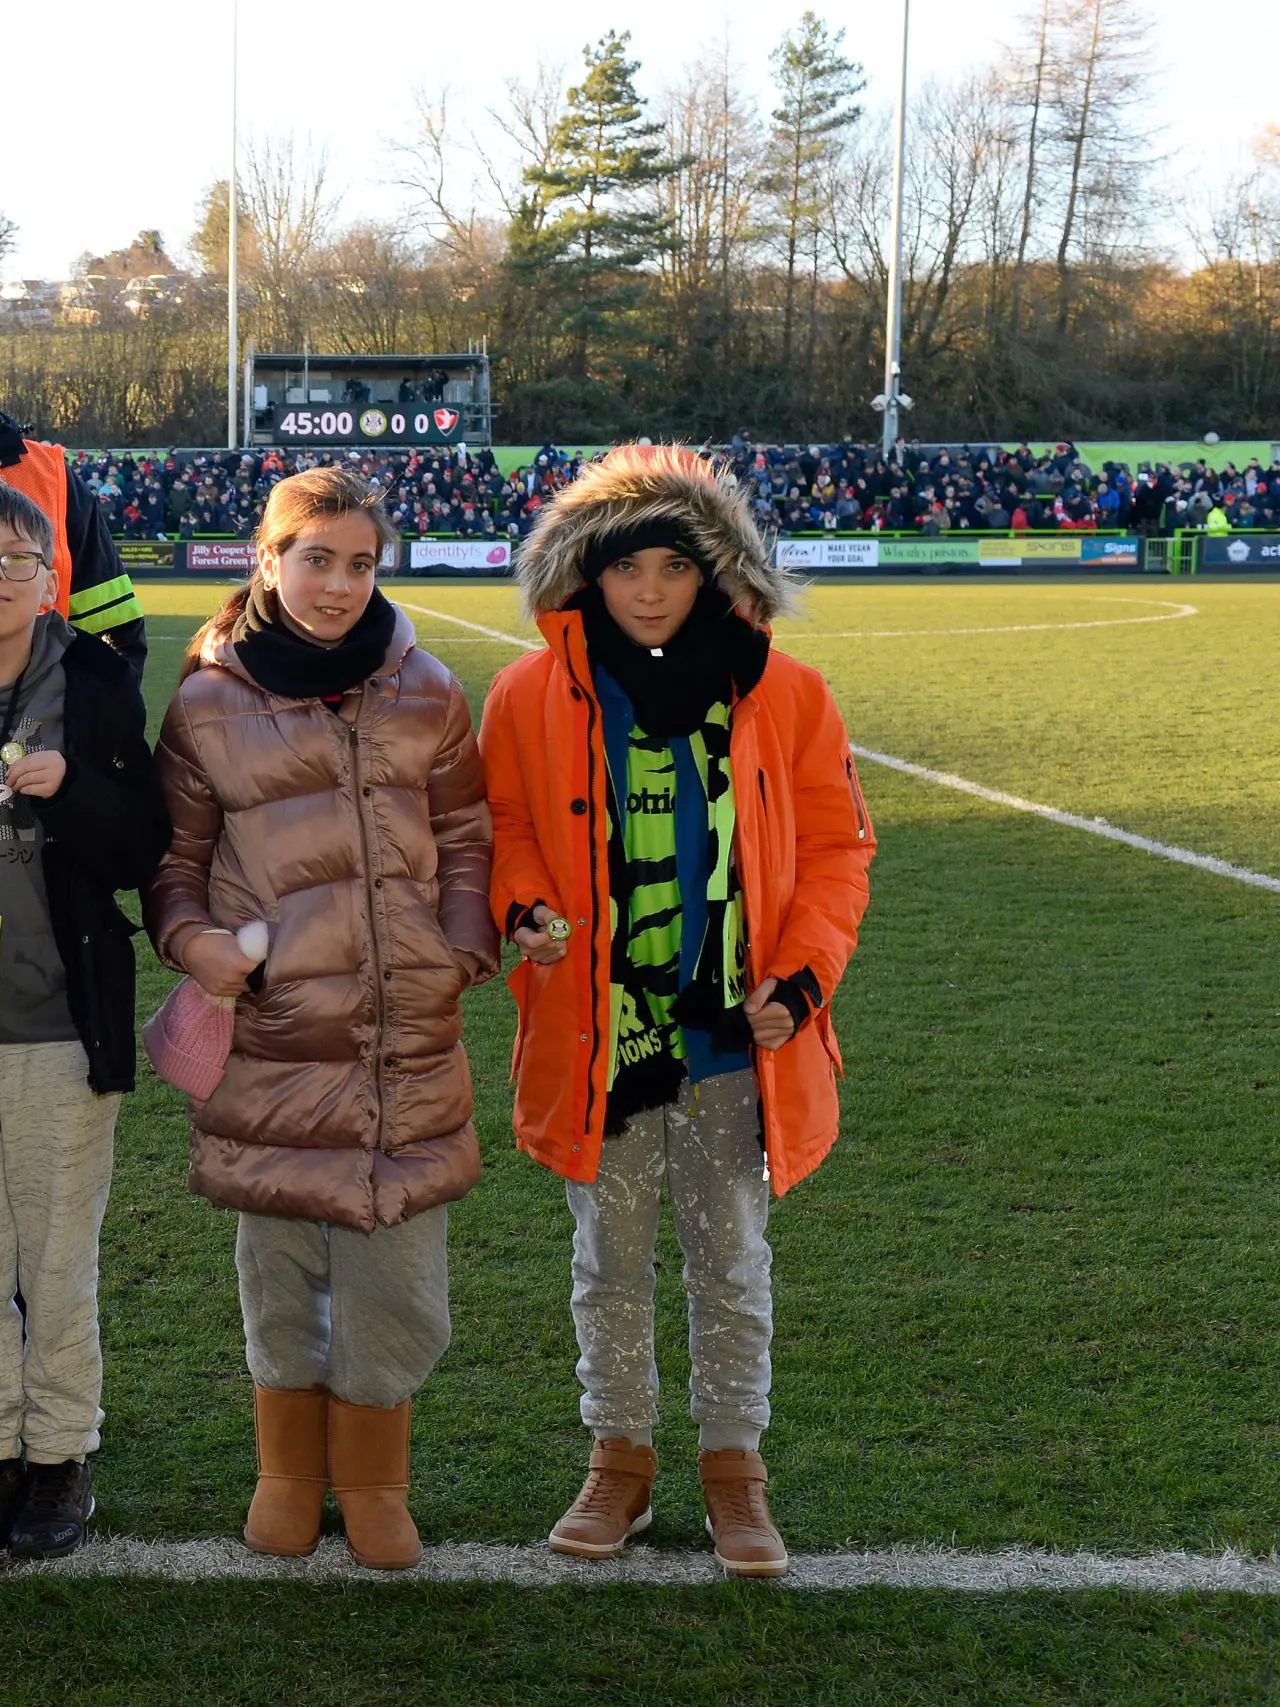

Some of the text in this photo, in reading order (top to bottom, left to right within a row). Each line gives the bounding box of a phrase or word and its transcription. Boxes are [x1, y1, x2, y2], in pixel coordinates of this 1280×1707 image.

[280, 412, 353, 435] 45:00
[391, 414, 406, 434] 0
[414, 414, 429, 434] 0
[192, 544, 210, 556] Jilly
[212, 545, 245, 556] Cooper
[827, 544, 871, 552] MAKE VEGAN
[1104, 542, 1136, 555] Signs
[192, 556, 219, 565] Forest
[220, 556, 247, 566] Green
[828, 554, 864, 563] YOUR GOAL
